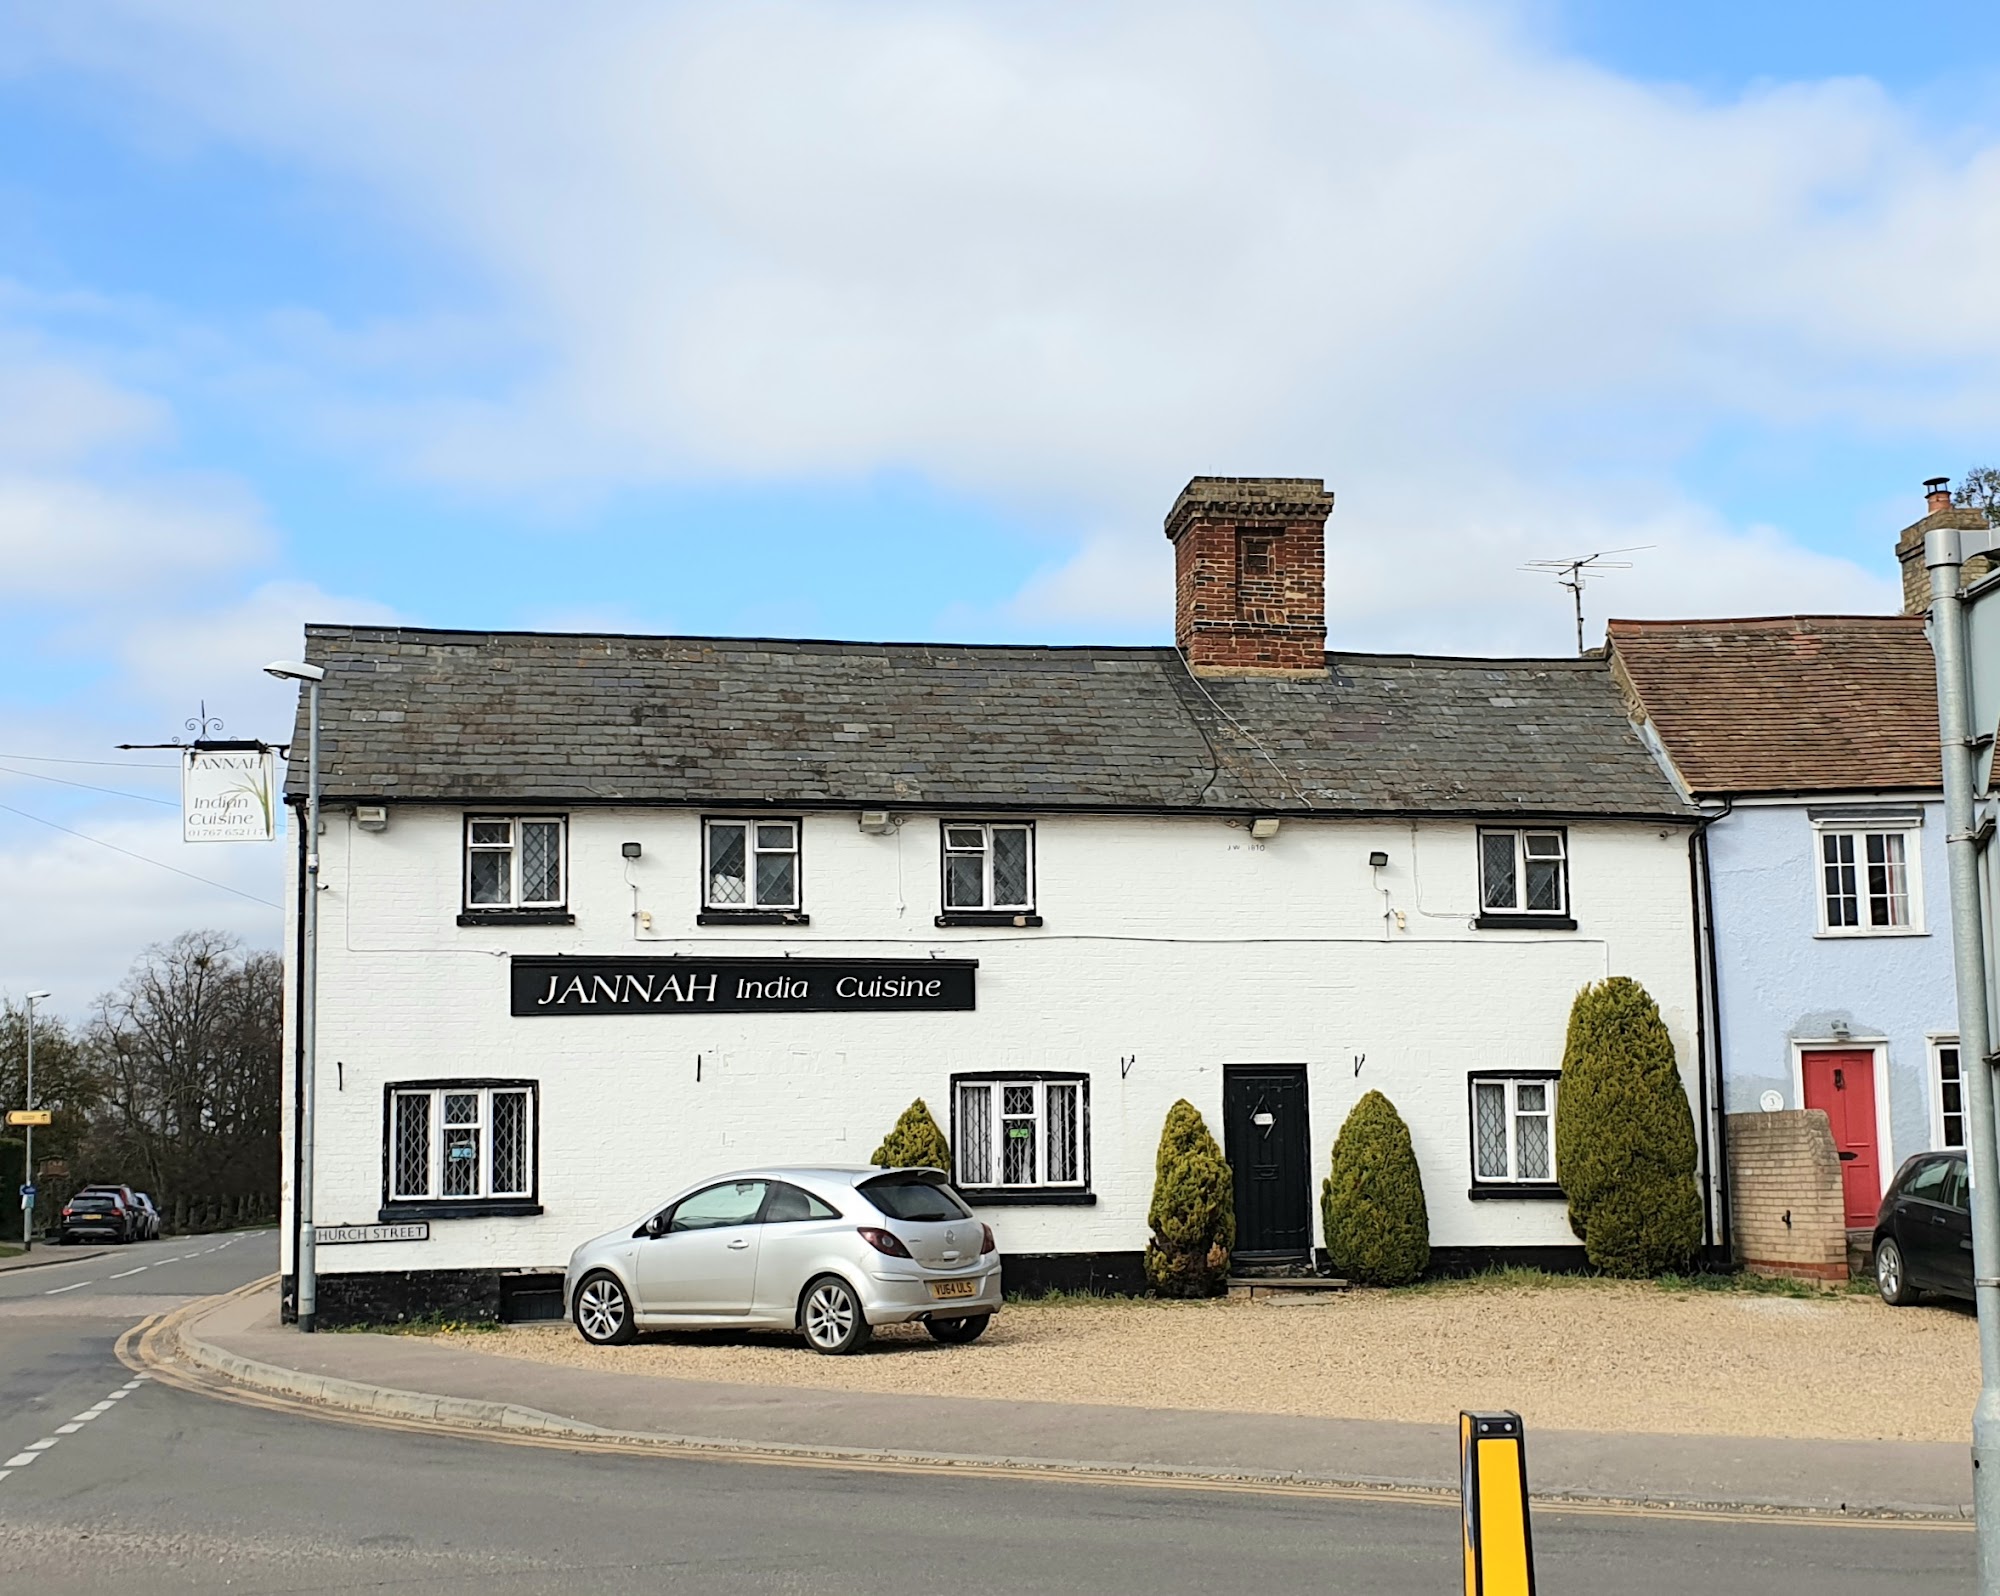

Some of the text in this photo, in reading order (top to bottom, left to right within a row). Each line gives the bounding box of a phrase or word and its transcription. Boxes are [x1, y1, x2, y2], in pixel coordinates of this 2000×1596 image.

[187, 757, 263, 770] JANNAH
[195, 796, 248, 809] Indian
[189, 812, 254, 825] Cuisine
[538, 975, 941, 1004] JANNAH India Cuisine
[318, 1226, 425, 1240] HURCH STREET
